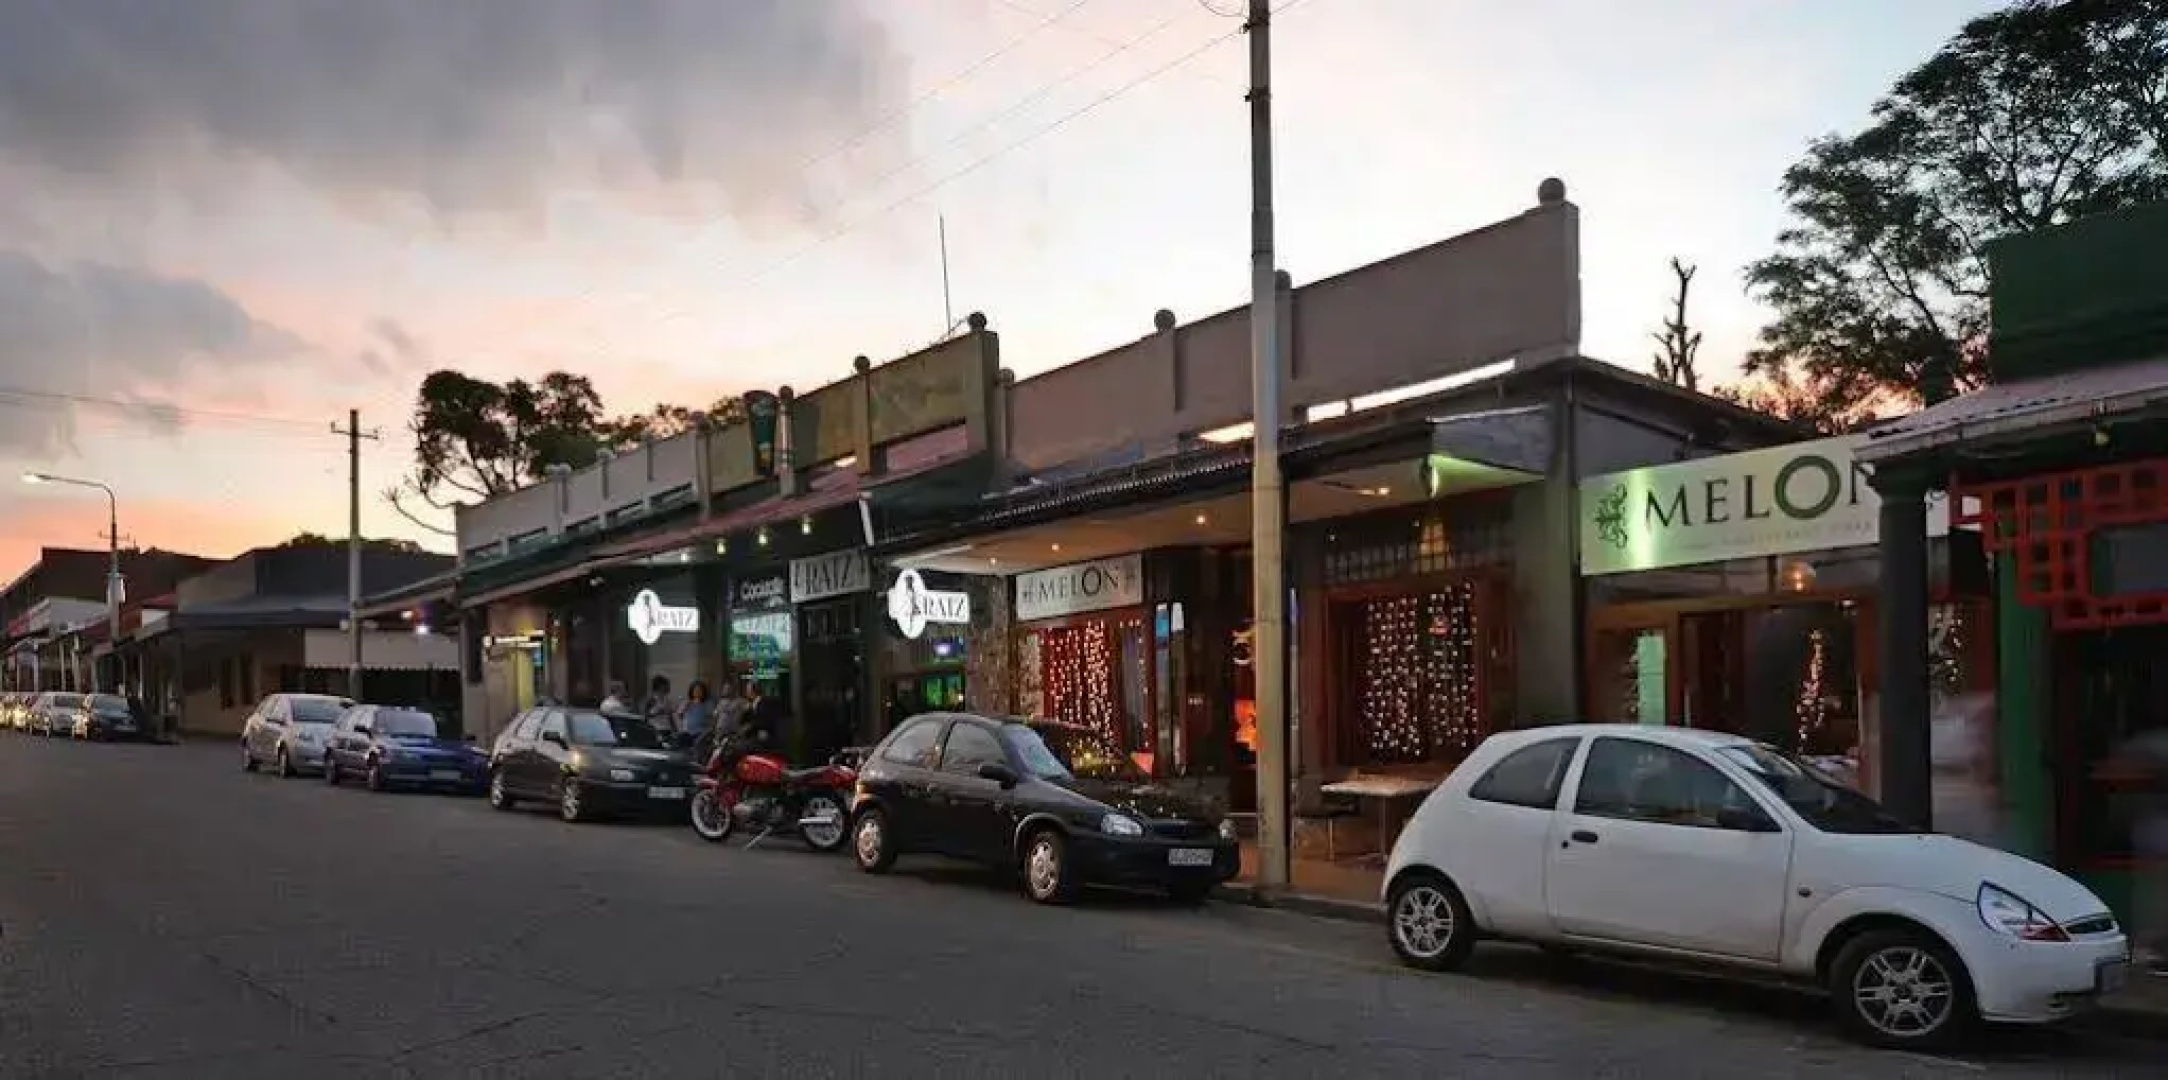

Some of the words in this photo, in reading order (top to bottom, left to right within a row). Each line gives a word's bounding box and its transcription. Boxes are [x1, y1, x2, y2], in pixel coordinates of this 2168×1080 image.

[1039, 563, 1120, 602] MELON
[923, 596, 966, 617] RATZ
[657, 610, 696, 627] RATZ
